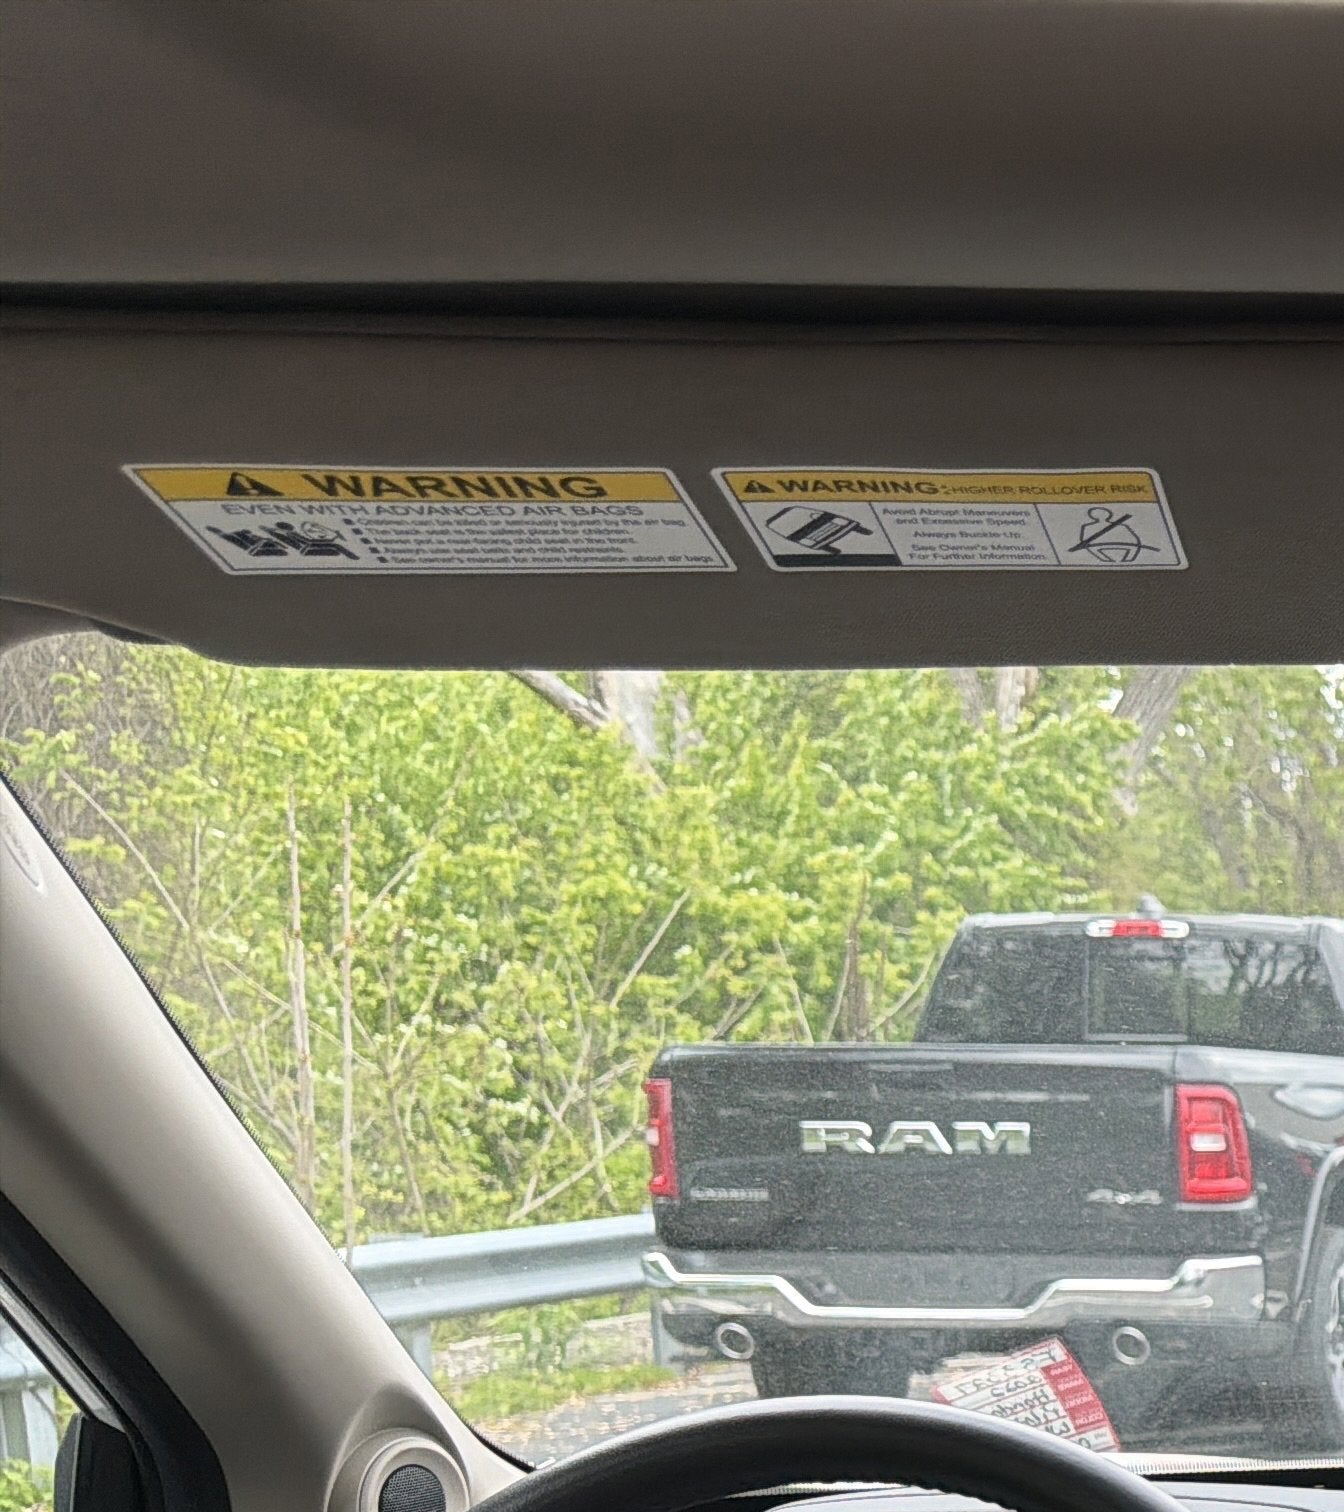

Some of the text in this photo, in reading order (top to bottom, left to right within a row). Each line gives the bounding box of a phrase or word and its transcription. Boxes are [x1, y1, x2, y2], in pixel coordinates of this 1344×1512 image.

[301, 473, 608, 498] WARNING
[951, 486, 1015, 495] HIGHER
[1018, 485, 1108, 494] ROLLOVER
[1110, 484, 1149, 494] RISK
[221, 504, 644, 516] EVEN WITH ADVANCED AIR BAGS
[799, 1119, 1032, 1155] RAM
